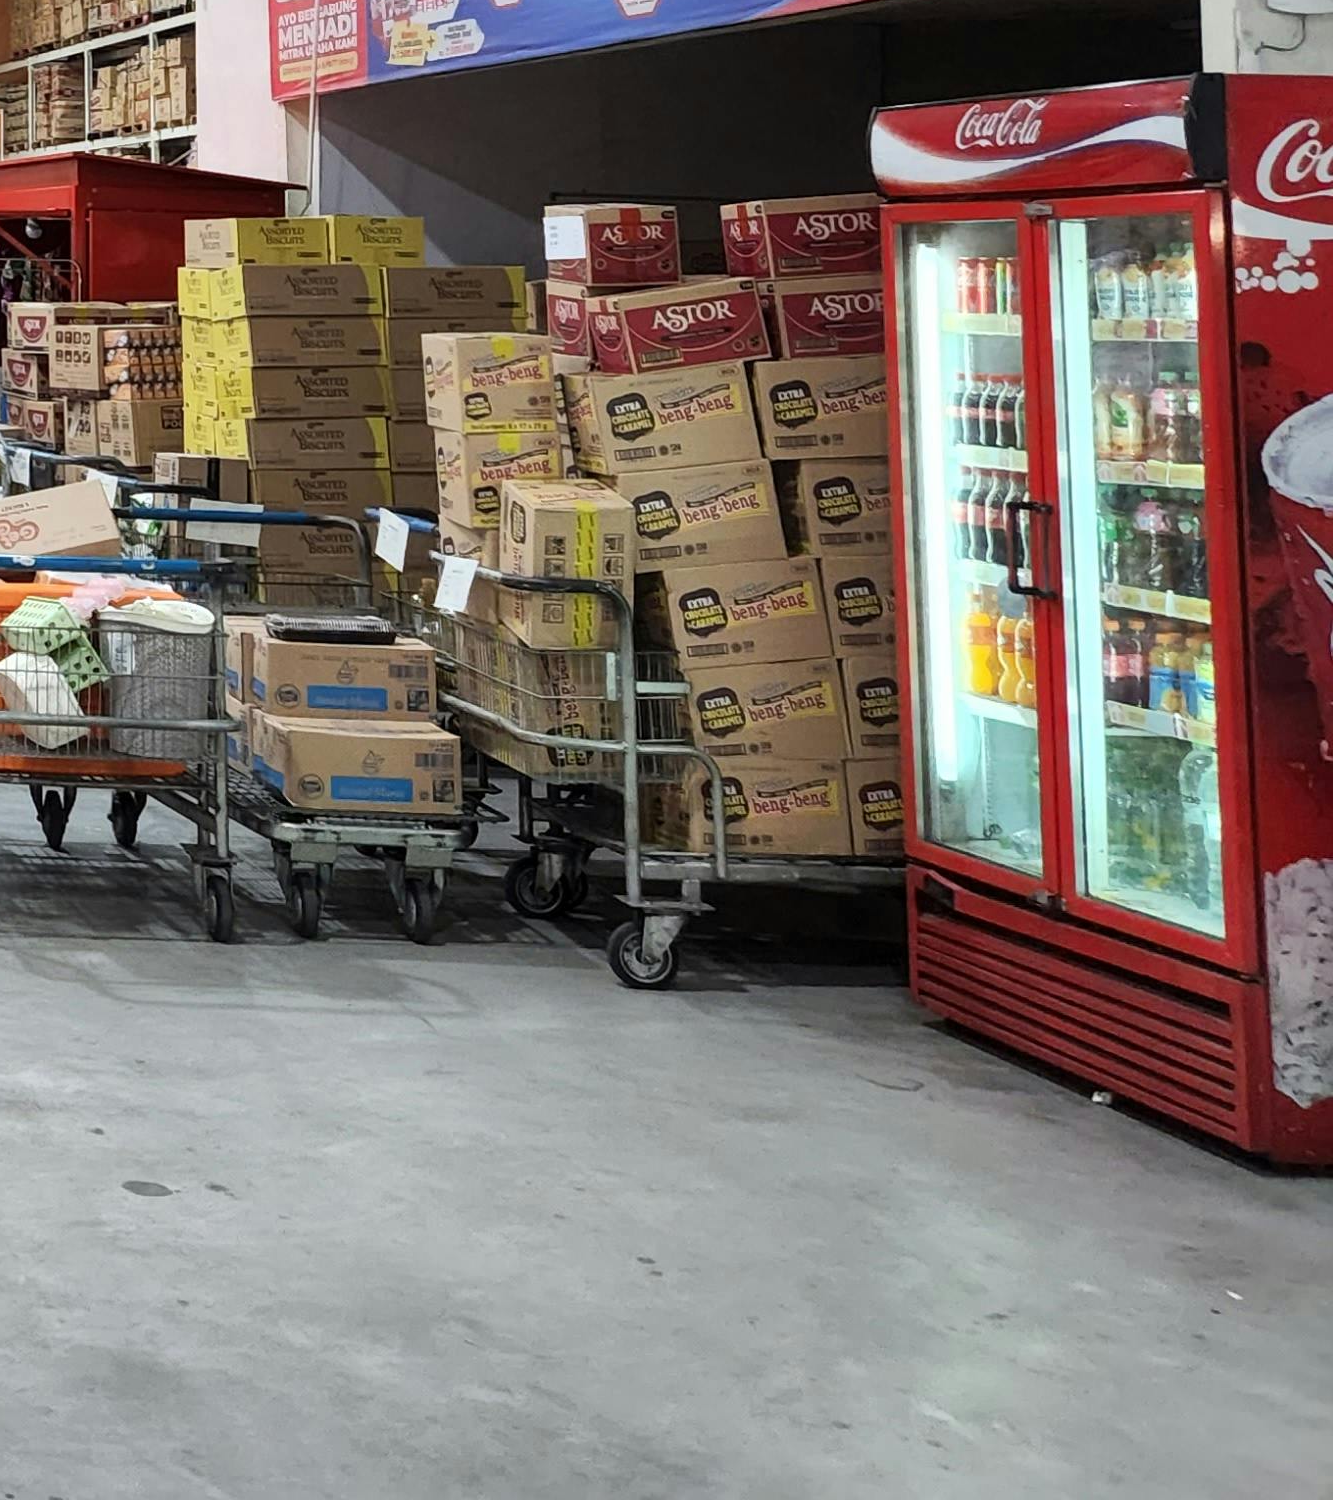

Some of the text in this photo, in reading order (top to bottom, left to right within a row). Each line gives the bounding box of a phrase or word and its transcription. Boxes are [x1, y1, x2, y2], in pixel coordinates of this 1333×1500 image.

[278, 12, 296, 28] AYO
[278, 12, 357, 49] MENJADI
[335, 36, 357, 50] KAMI
[260, 226, 305, 236] ASSORTED
[356, 225, 402, 235] ASSORTED
[793, 212, 877, 240] ASTOR
[266, 235, 305, 244] BISCUITS
[362, 235, 403, 244] BISCUITS
[600, 224, 666, 245] ASOR
[284, 274, 338, 288] ASSORTED
[293, 286, 339, 296] BISCUITS
[651, 299, 737, 334] ASTOR
[295, 374, 349, 388] ASSORTED
[472, 362, 543, 388] beng-beng
[304, 387, 350, 398] BISCUITS
[777, 388, 805, 400] EXTRA
[613, 400, 642, 414] EXTRA
[656, 394, 736, 425] beng-beng
[290, 428, 345, 441] ASSORTED
[300, 440, 345, 450] BISCUITS
[480, 458, 551, 481] beng-beng
[293, 478, 347, 491] ASSORTED
[821, 485, 848, 497] EXTRA
[302, 490, 348, 502] BISCUITS
[639, 499, 667, 513] EXTRA
[682, 493, 760, 524] beng-beng
[686, 596, 715, 609] EXTRA
[729, 592, 809, 621] beng-beng
[704, 696, 732, 709] EXTRA
[748, 692, 826, 722] beng-beng
[752, 790, 831, 814] beng-beng
